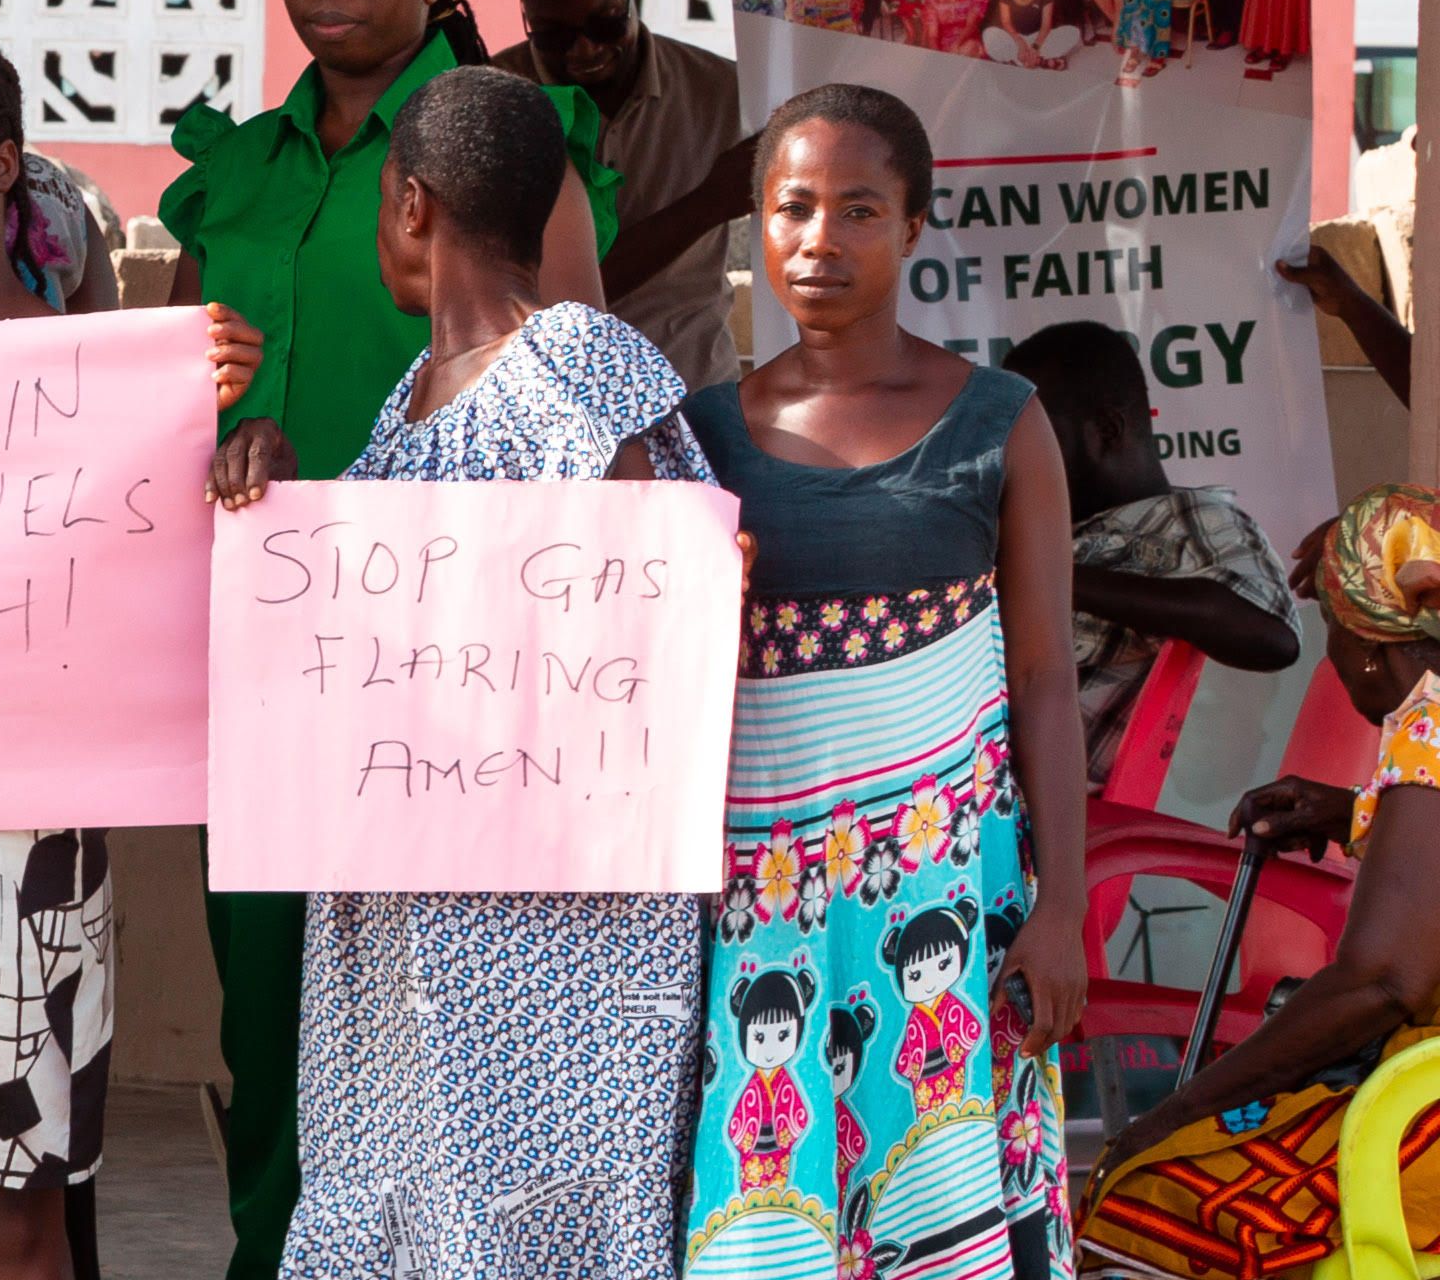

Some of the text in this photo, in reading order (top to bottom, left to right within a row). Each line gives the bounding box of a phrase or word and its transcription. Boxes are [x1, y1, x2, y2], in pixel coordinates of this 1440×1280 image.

[928, 168, 1270, 230] CAN WOMEN
[909, 245, 1163, 303] OF FAITH
[5, 341, 82, 451] IN
[1153, 428, 1242, 461] DING
[256, 521, 668, 613] STOP GAS
[303, 634, 649, 704] FLARING
[384, 1192, 403, 1247] SEIGNEUR
